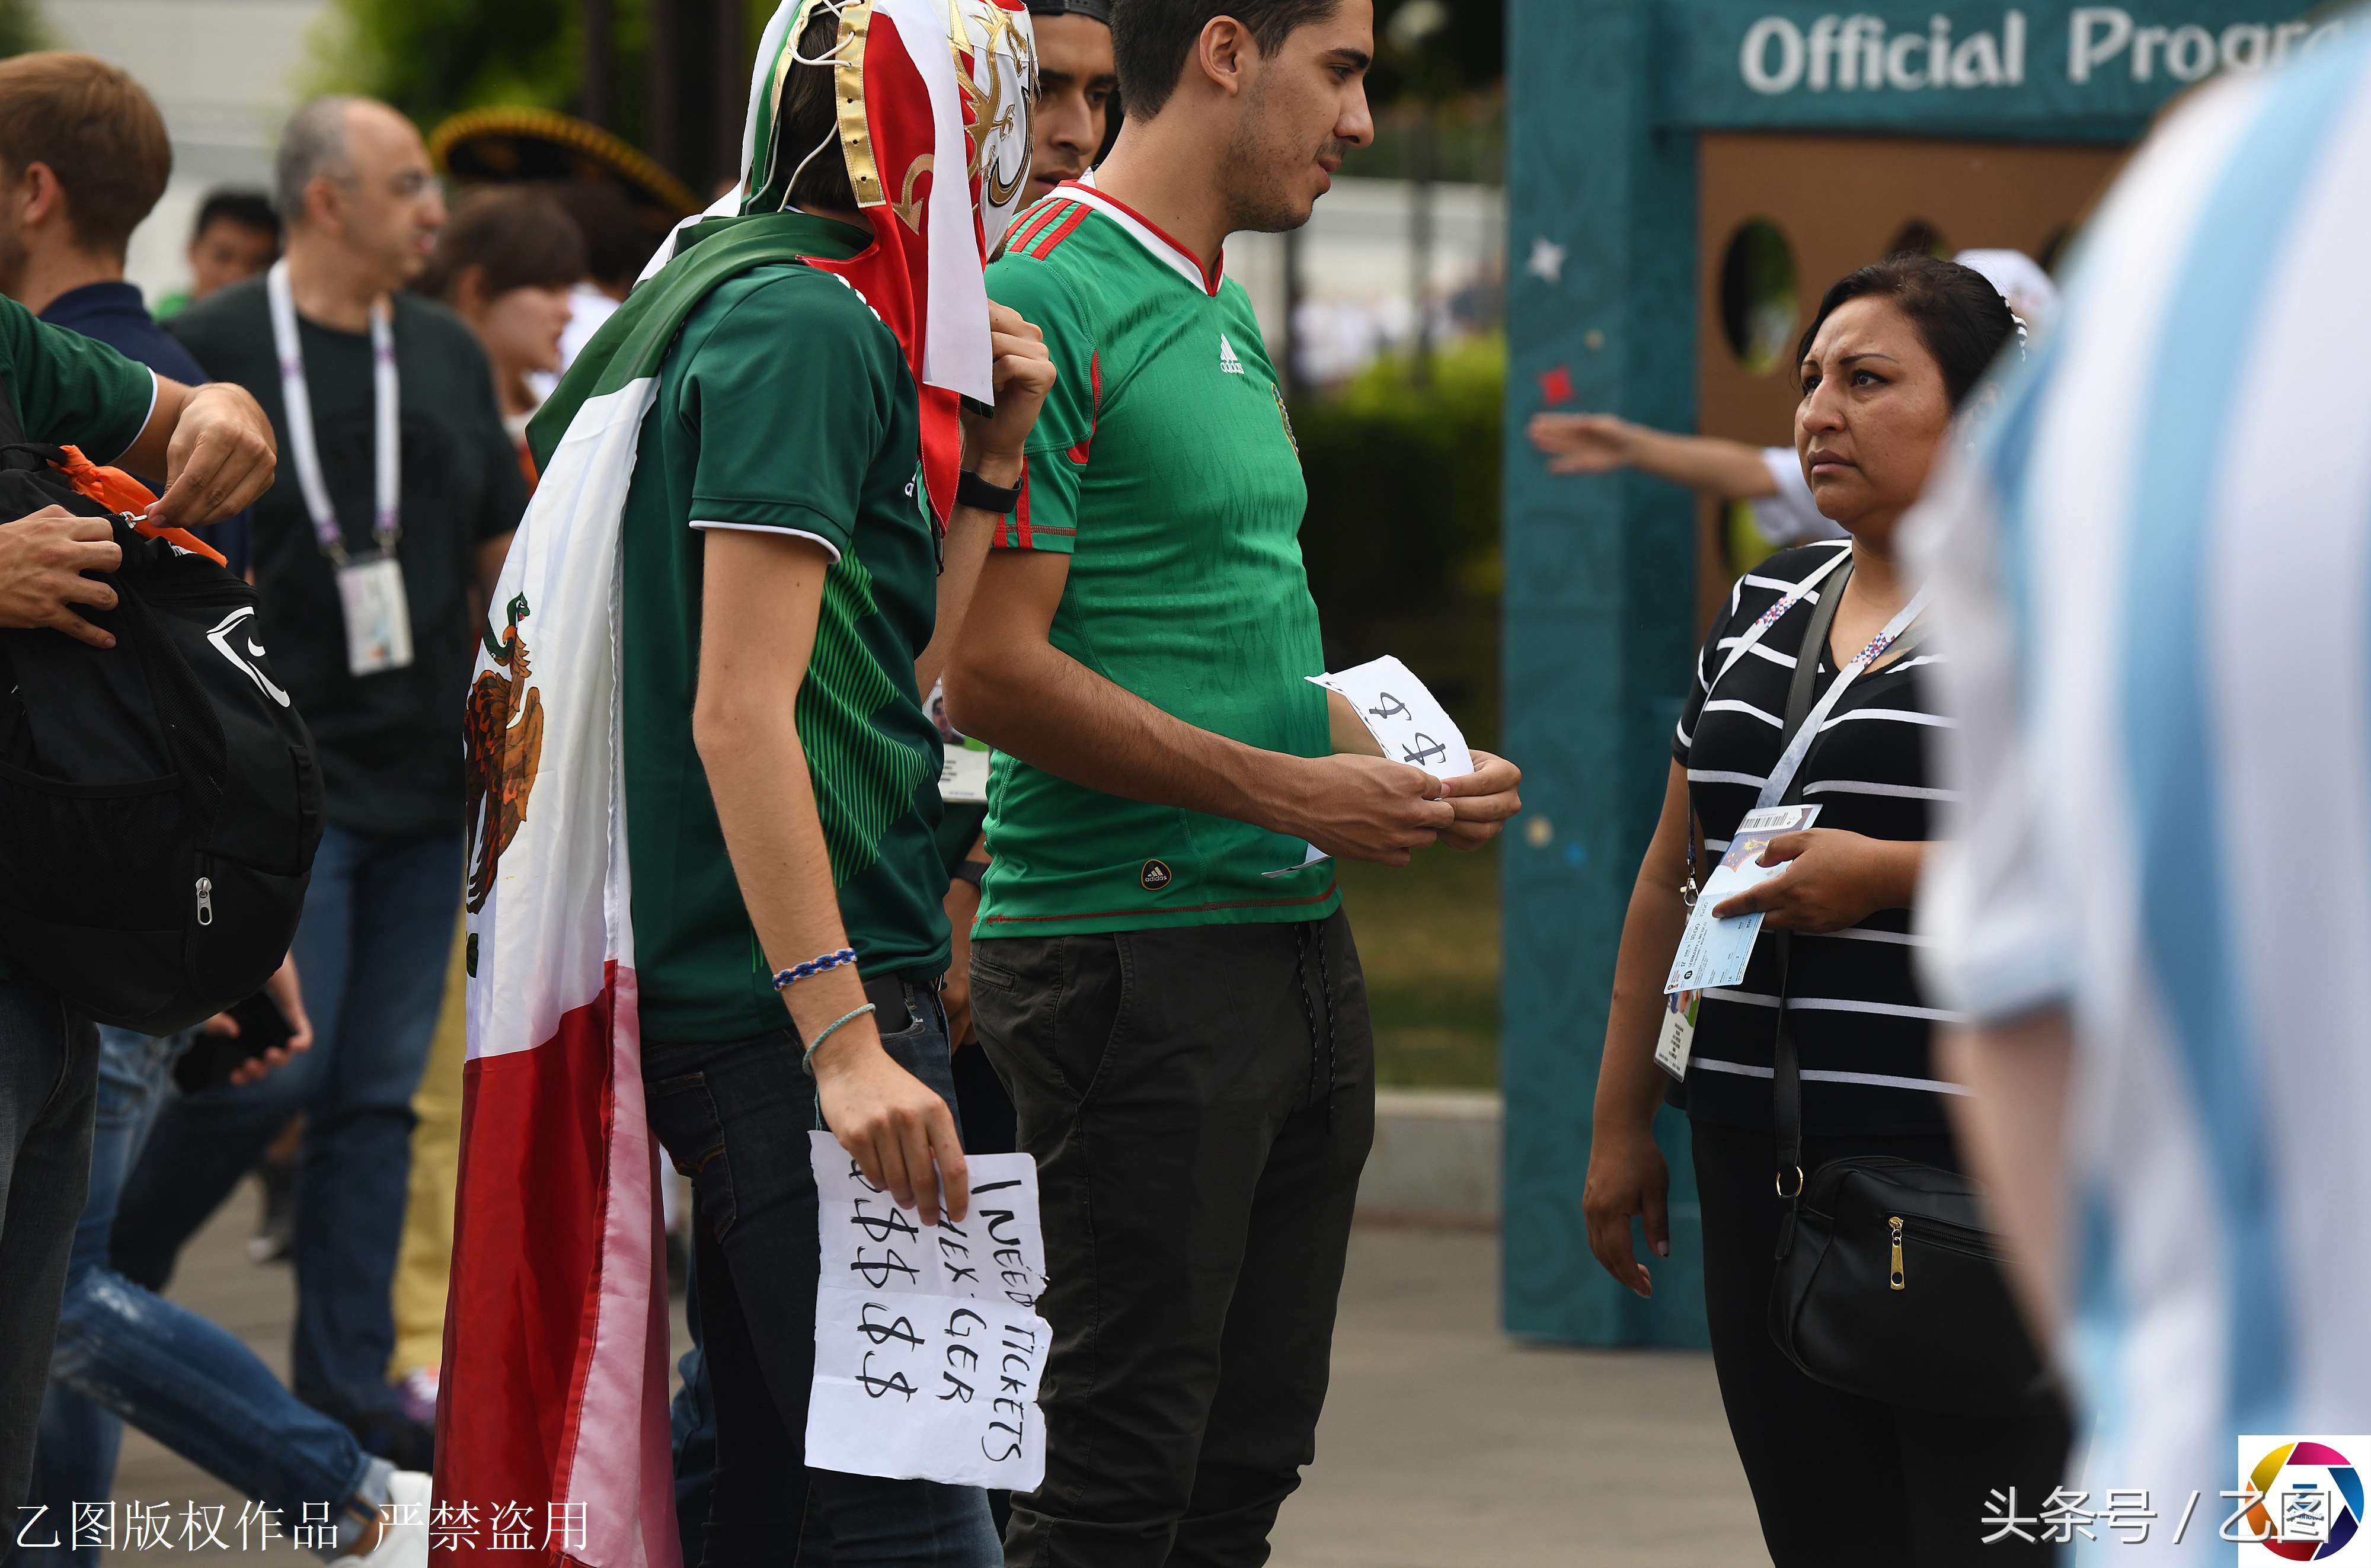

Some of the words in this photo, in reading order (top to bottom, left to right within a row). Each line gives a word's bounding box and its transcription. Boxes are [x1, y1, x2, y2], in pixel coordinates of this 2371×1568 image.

[1739, 7, 2026, 93] Official
[1221, 360, 1244, 374] adidas
[970, 1179, 1022, 1195] I
[979, 1209, 1034, 1308] NEED
[982, 1324, 1036, 1462] TICKETS
